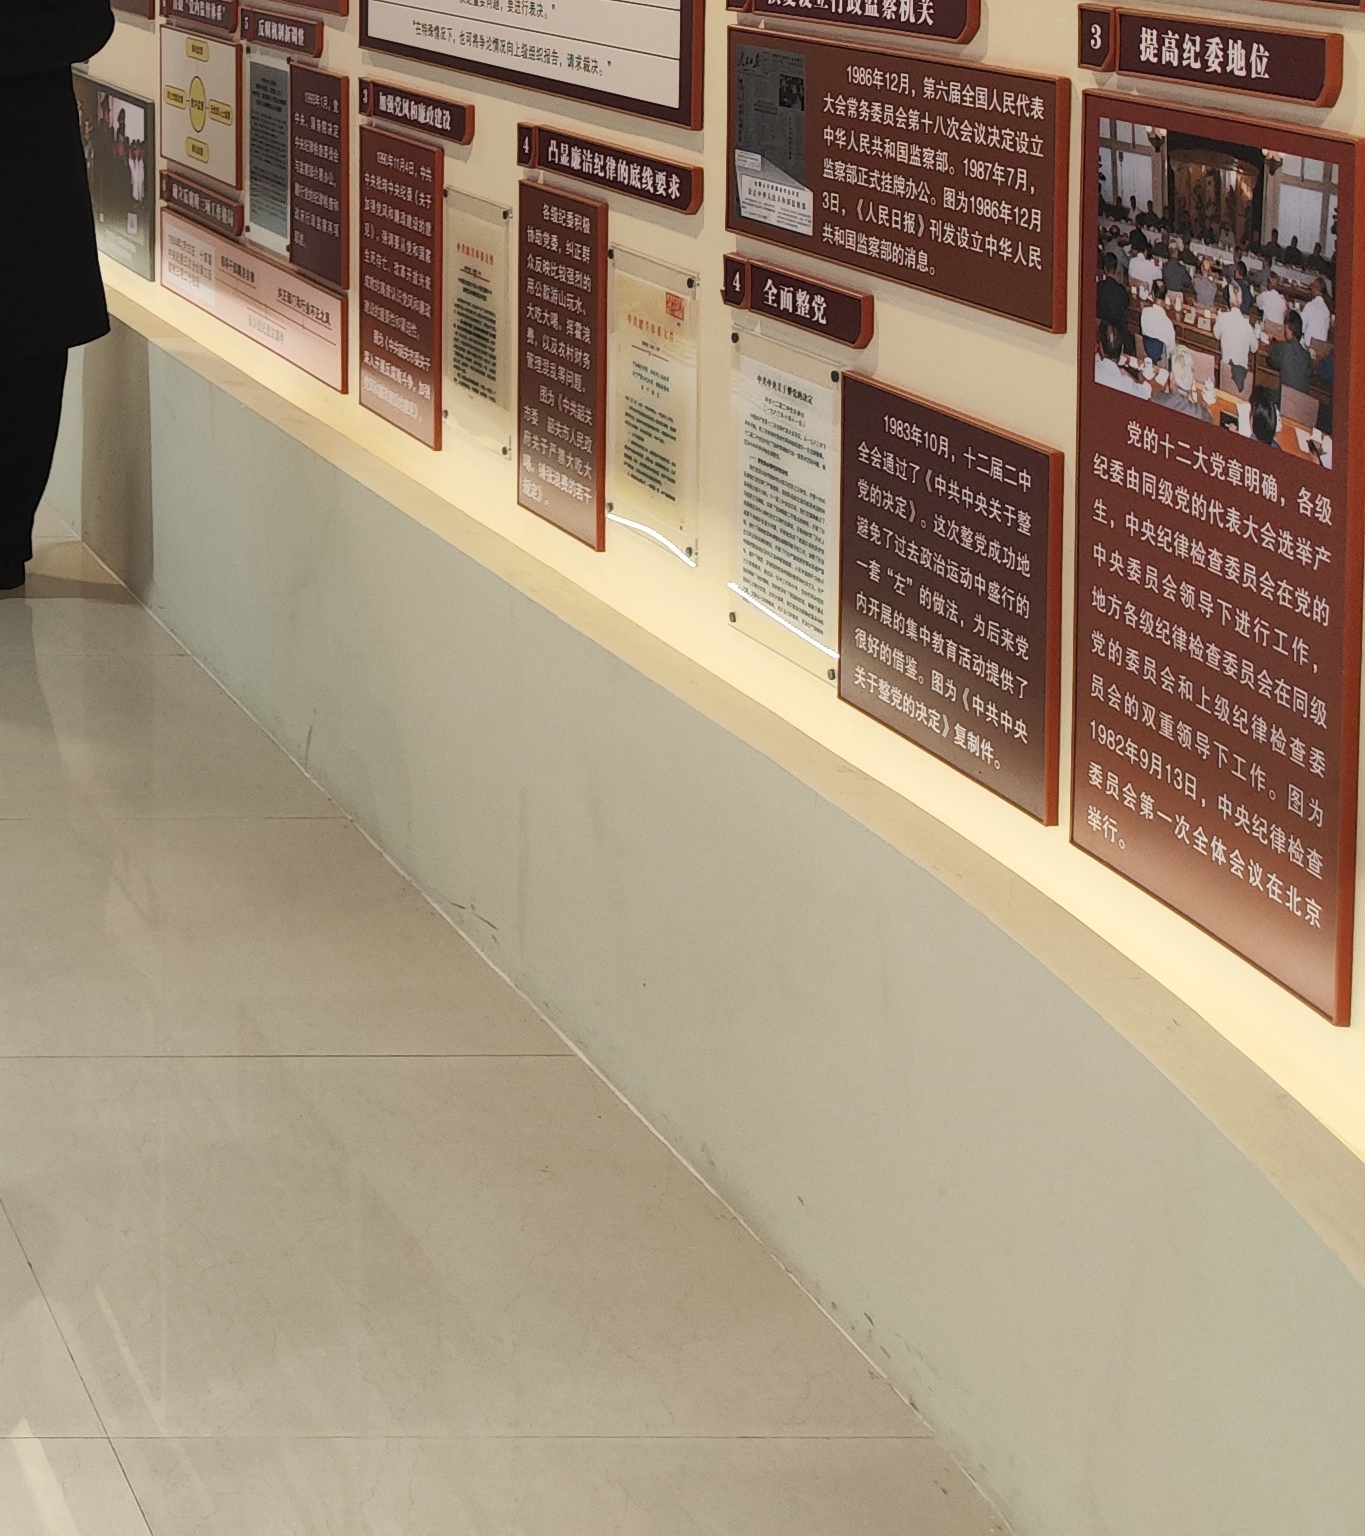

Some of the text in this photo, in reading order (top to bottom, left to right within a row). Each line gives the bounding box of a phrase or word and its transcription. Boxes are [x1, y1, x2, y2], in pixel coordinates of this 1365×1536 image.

[1090, 24, 1102, 49] 3
[1140, 26, 1269, 79] 提高纪委地位
[823, 93, 1044, 157] 大会常务委员会第十八次会议决定设立
[847, 65, 1044, 120] 1986年12月，第六届全国人民代表
[548, 140, 681, 200] 凸显廉洁纪律的底线要求
[823, 127, 1036, 195] 中华人民共和国监察部。1987年7月，
[823, 157, 1042, 233] 监察部正式挂牌办公。图为1986年12月
[822, 192, 1041, 270] 3日，《人民日报》刊发设立中华人民
[822, 222, 935, 275] 共和国监察部的消息。
[732, 272, 741, 291] 4
[763, 279, 826, 325] 全面整党
[857, 443, 1031, 537] 全会通过了《中共中央关于整
[883, 414, 1032, 489] 1983年10月，十二届二中
[1127, 420, 1333, 527] 党的十二大党章明确，各级
[857, 478, 1031, 578] 党的决定》。这次整党成功地
[1093, 453, 1331, 572] 纪委由同级党的代表大会选举产
[856, 515, 1030, 620] 避免了过去政治运动中盛行的
[1093, 497, 1330, 626] 生，中央纪律检查委员会在党的
[1093, 543, 1318, 671] 中央委员会领导下进行工作，
[855, 628, 1028, 746] 很好的借鉴。图为《中共中央
[856, 591, 1029, 699] 内开展的集中教育活动提供了
[1092, 587, 1327, 729] 地方各级纪律检查委员会在同级
[854, 665, 1001, 770] 关于整党的决定》复制件。
[1090, 674, 1324, 829] 员会的双重领导下工作。图为
[1091, 630, 1326, 779] 党的委员会和上级纪律检查委
[1088, 805, 1126, 851] 举行。
[1089, 763, 1321, 928] 委员会第一次全体会议在北京
[1090, 719, 1322, 881] 1982年9月13日，中央纪律检查
